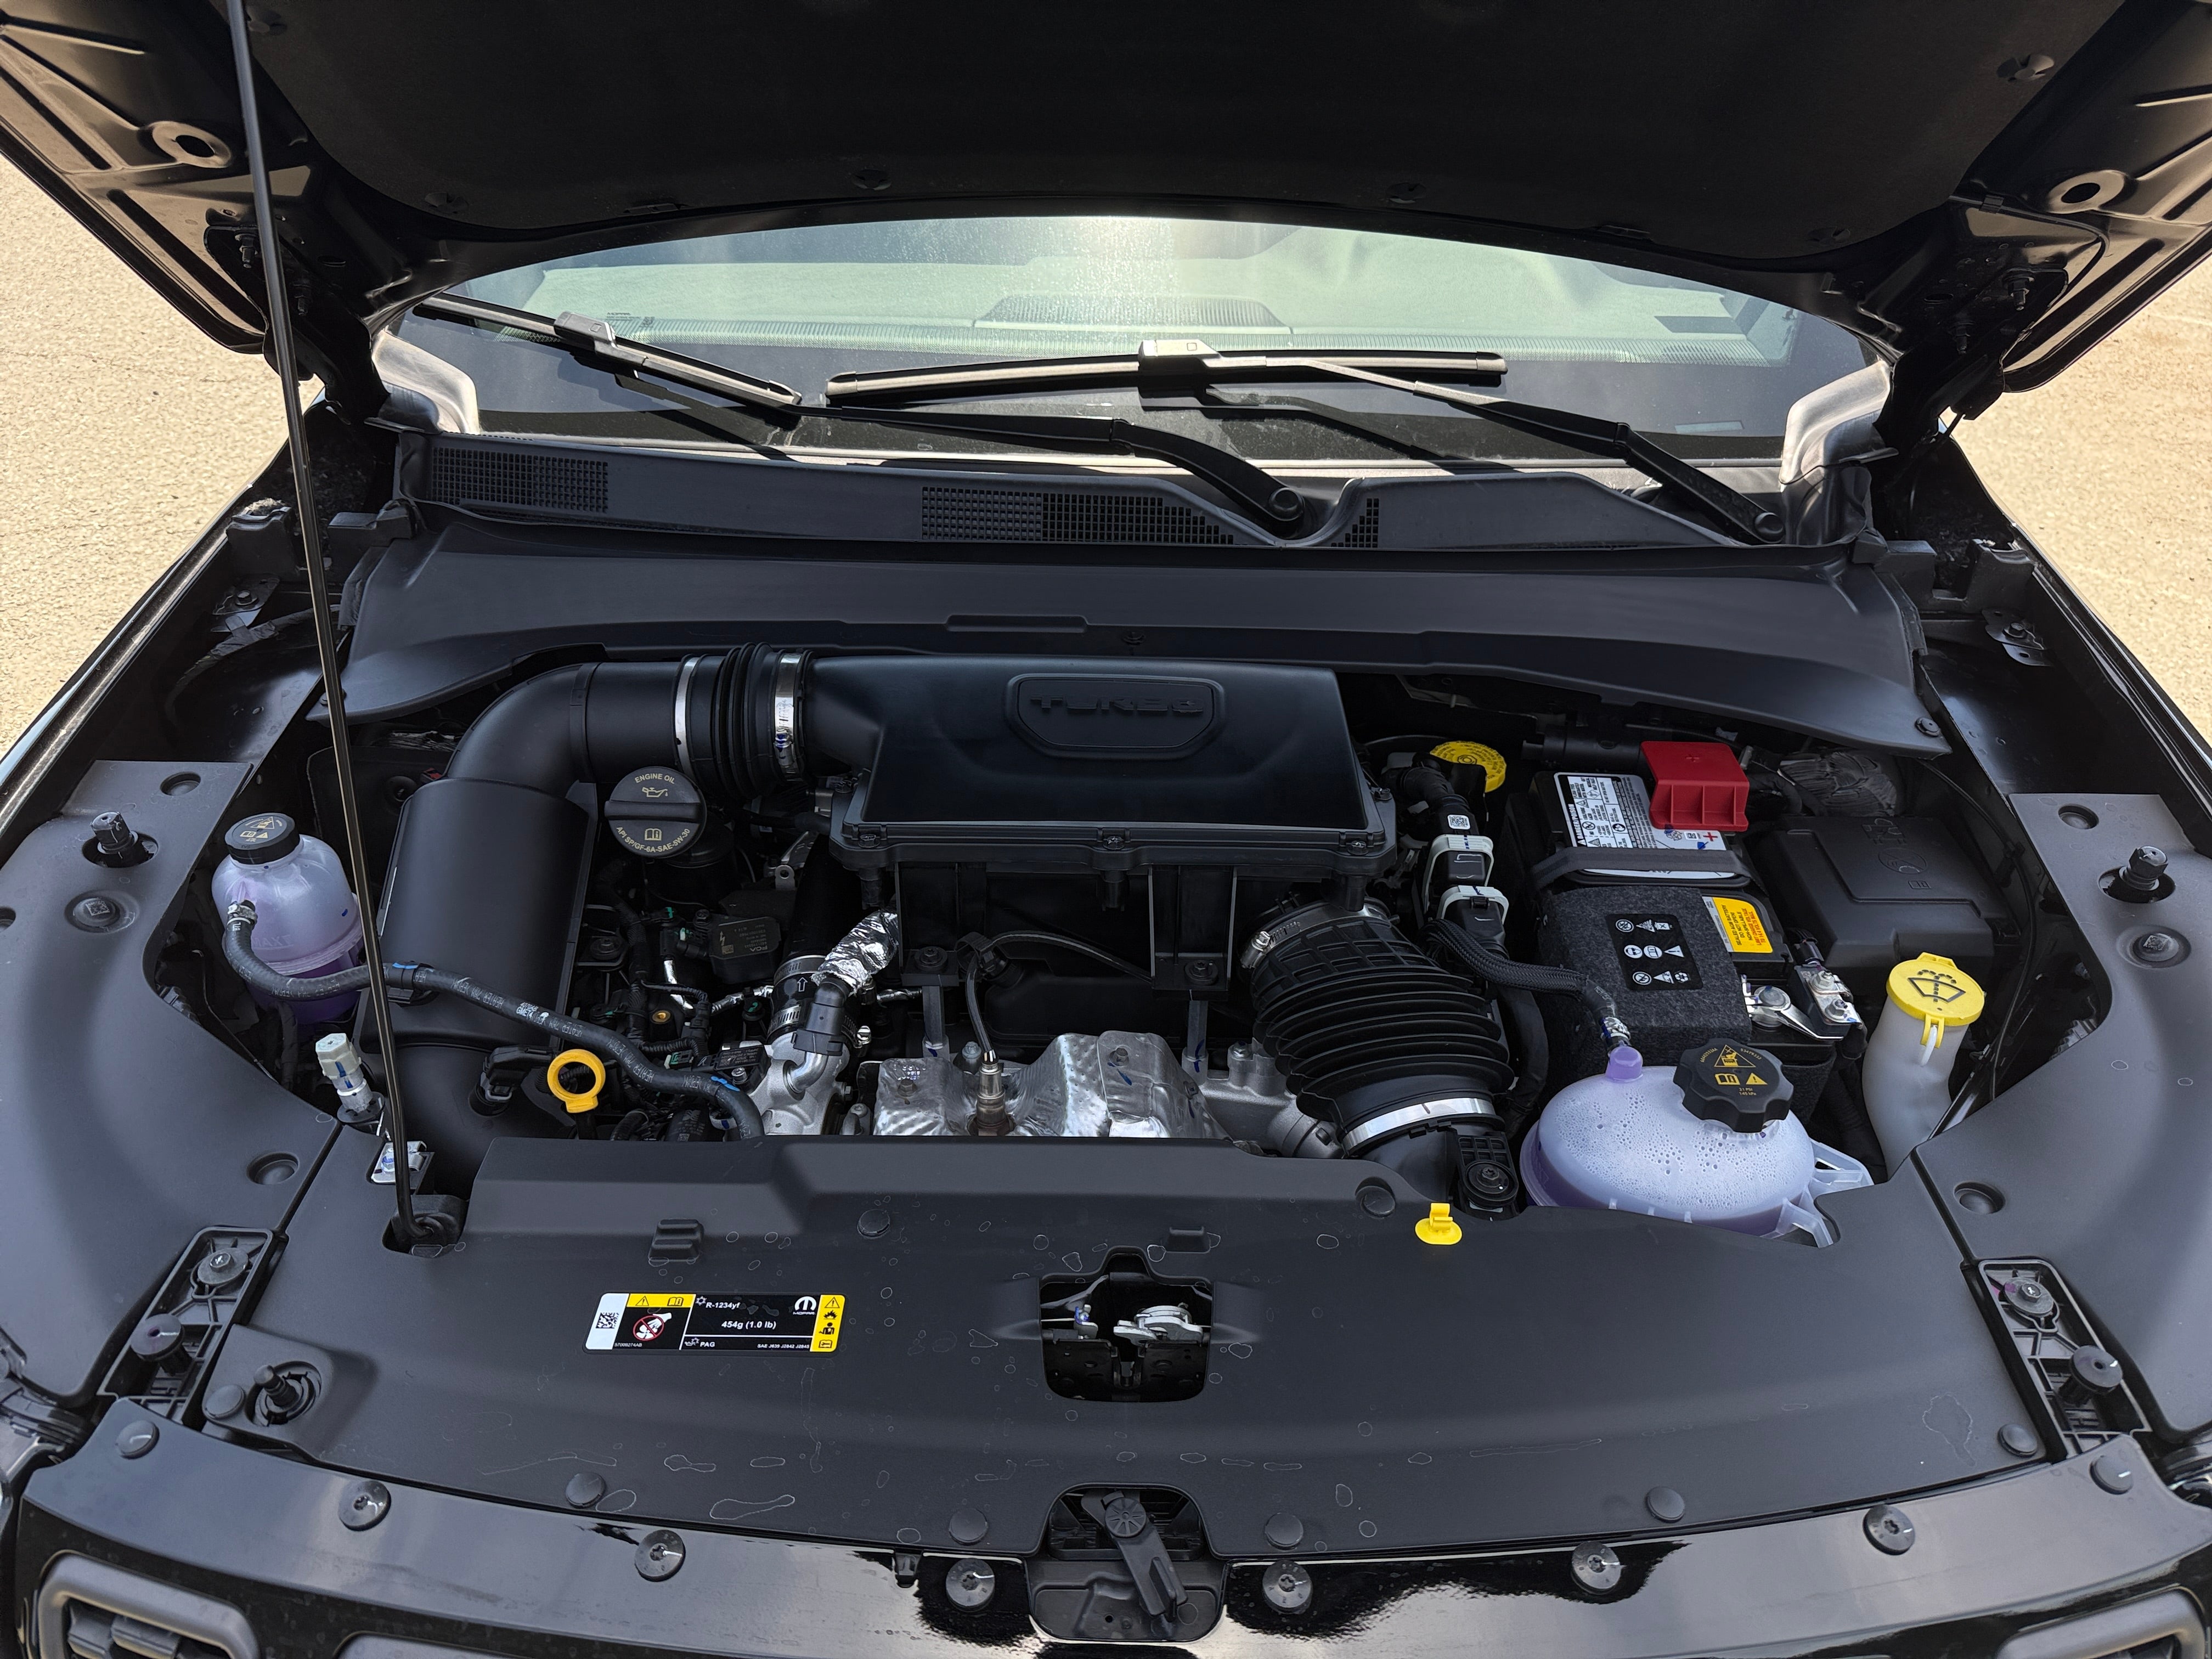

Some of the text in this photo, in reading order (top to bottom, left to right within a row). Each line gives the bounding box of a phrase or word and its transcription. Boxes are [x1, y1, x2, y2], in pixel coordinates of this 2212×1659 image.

[1030, 693, 1204, 713] TURBO
[634, 772, 675, 784] ENGINE OIL
[616, 826, 627, 838] API
[1720, 904, 1731, 922] BATTERY
[1736, 911, 1753, 941] NON-SPILLABLE
[1732, 930, 1742, 946] SEALED
[706, 1302, 741, 1310] R-1234yf
[721, 1321, 777, 1330] 454g (1.0 lb)
